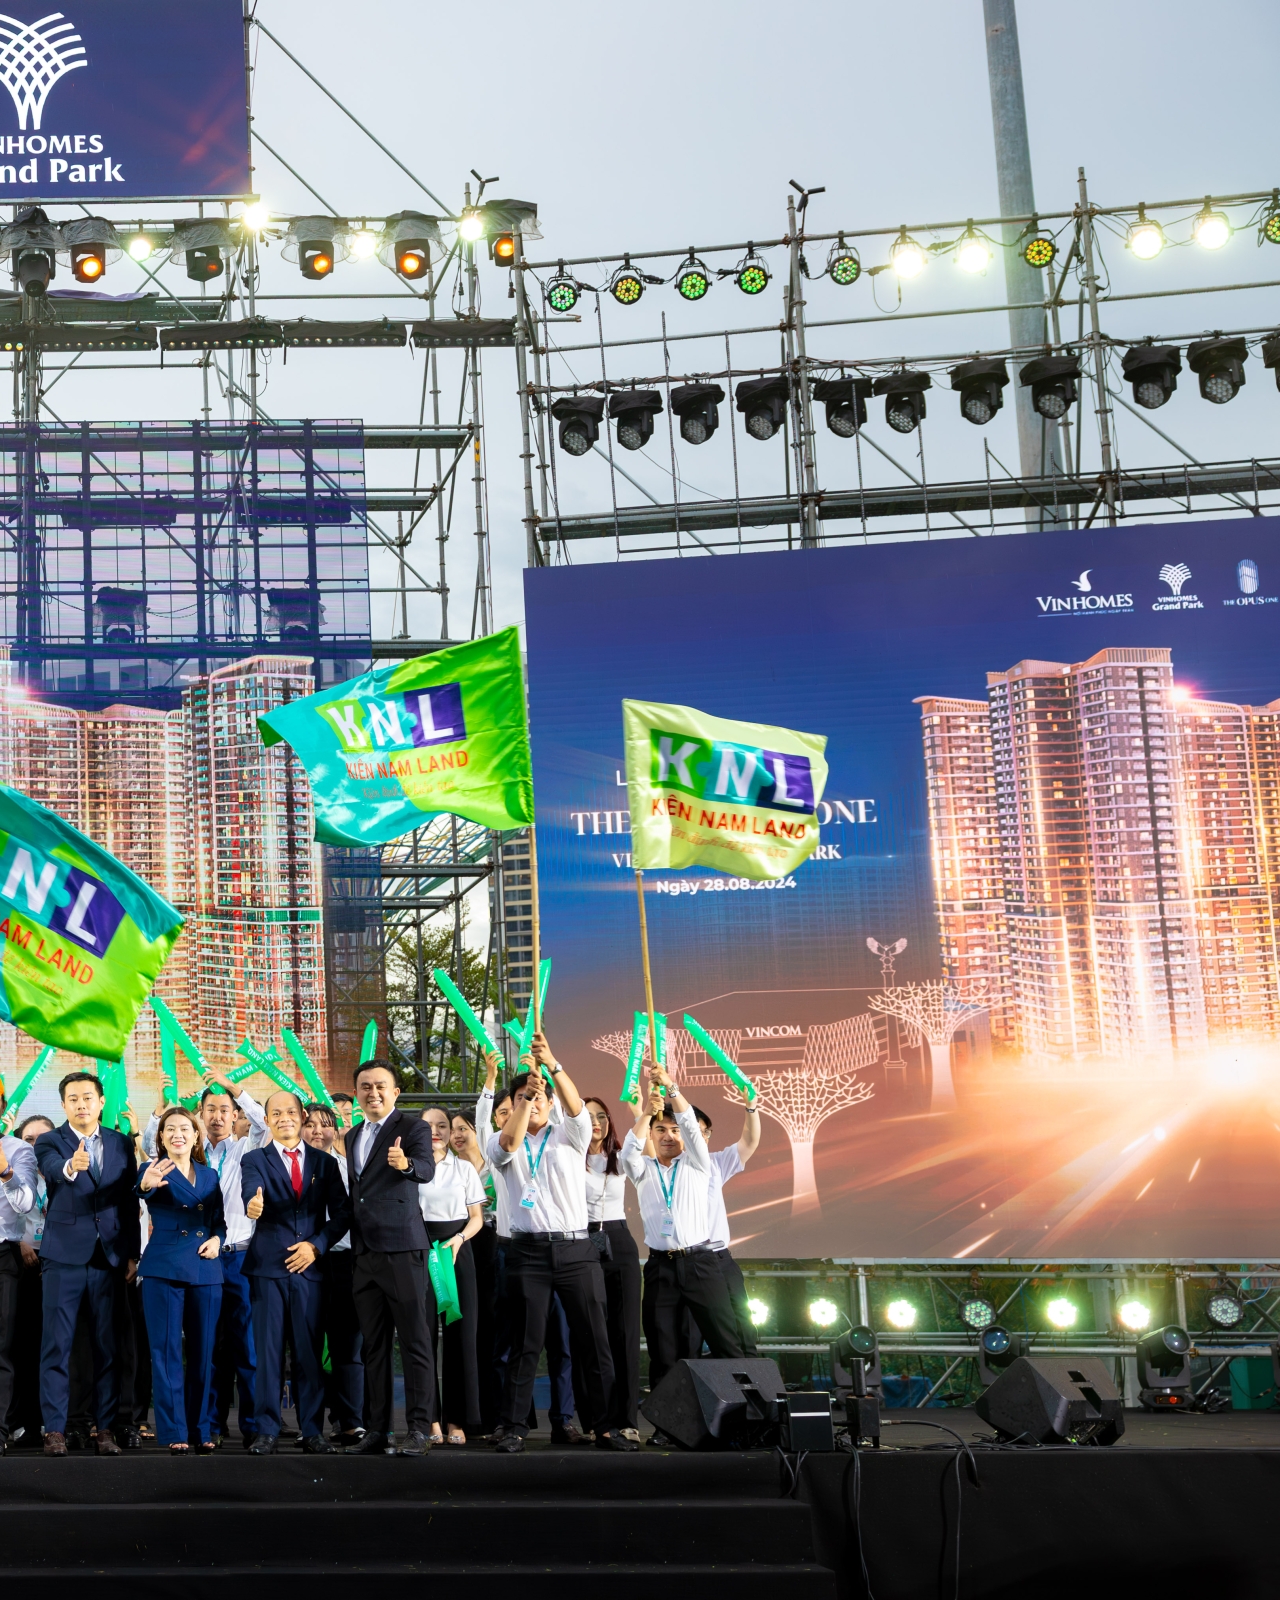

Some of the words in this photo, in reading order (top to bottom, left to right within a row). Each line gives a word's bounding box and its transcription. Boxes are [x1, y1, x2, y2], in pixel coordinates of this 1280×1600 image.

[49, 156, 126, 183] Park
[1036, 593, 1134, 612] VINHOMES
[1152, 602, 1181, 611] Grand
[1183, 600, 1204, 609] Park
[1157, 595, 1198, 603] VINHOMES
[1236, 596, 1265, 606] OPUS
[326, 694, 454, 747] KNL
[345, 758, 375, 780] KIÊN
[376, 760, 412, 779] NAM
[416, 750, 469, 774] LAND
[659, 737, 806, 808] KNL
[571, 810, 632, 835] THE
[651, 794, 693, 822] KIÊN
[698, 810, 747, 833] NAM
[752, 816, 807, 840] LAND
[656, 880, 701, 896] Ngày
[704, 876, 797, 892] 28.08.2024
[36, 938, 94, 985] LAND
[745, 1025, 803, 1038] VINCOM
[247, 1044, 265, 1065] LAND
[235, 1064, 254, 1078] NAM
